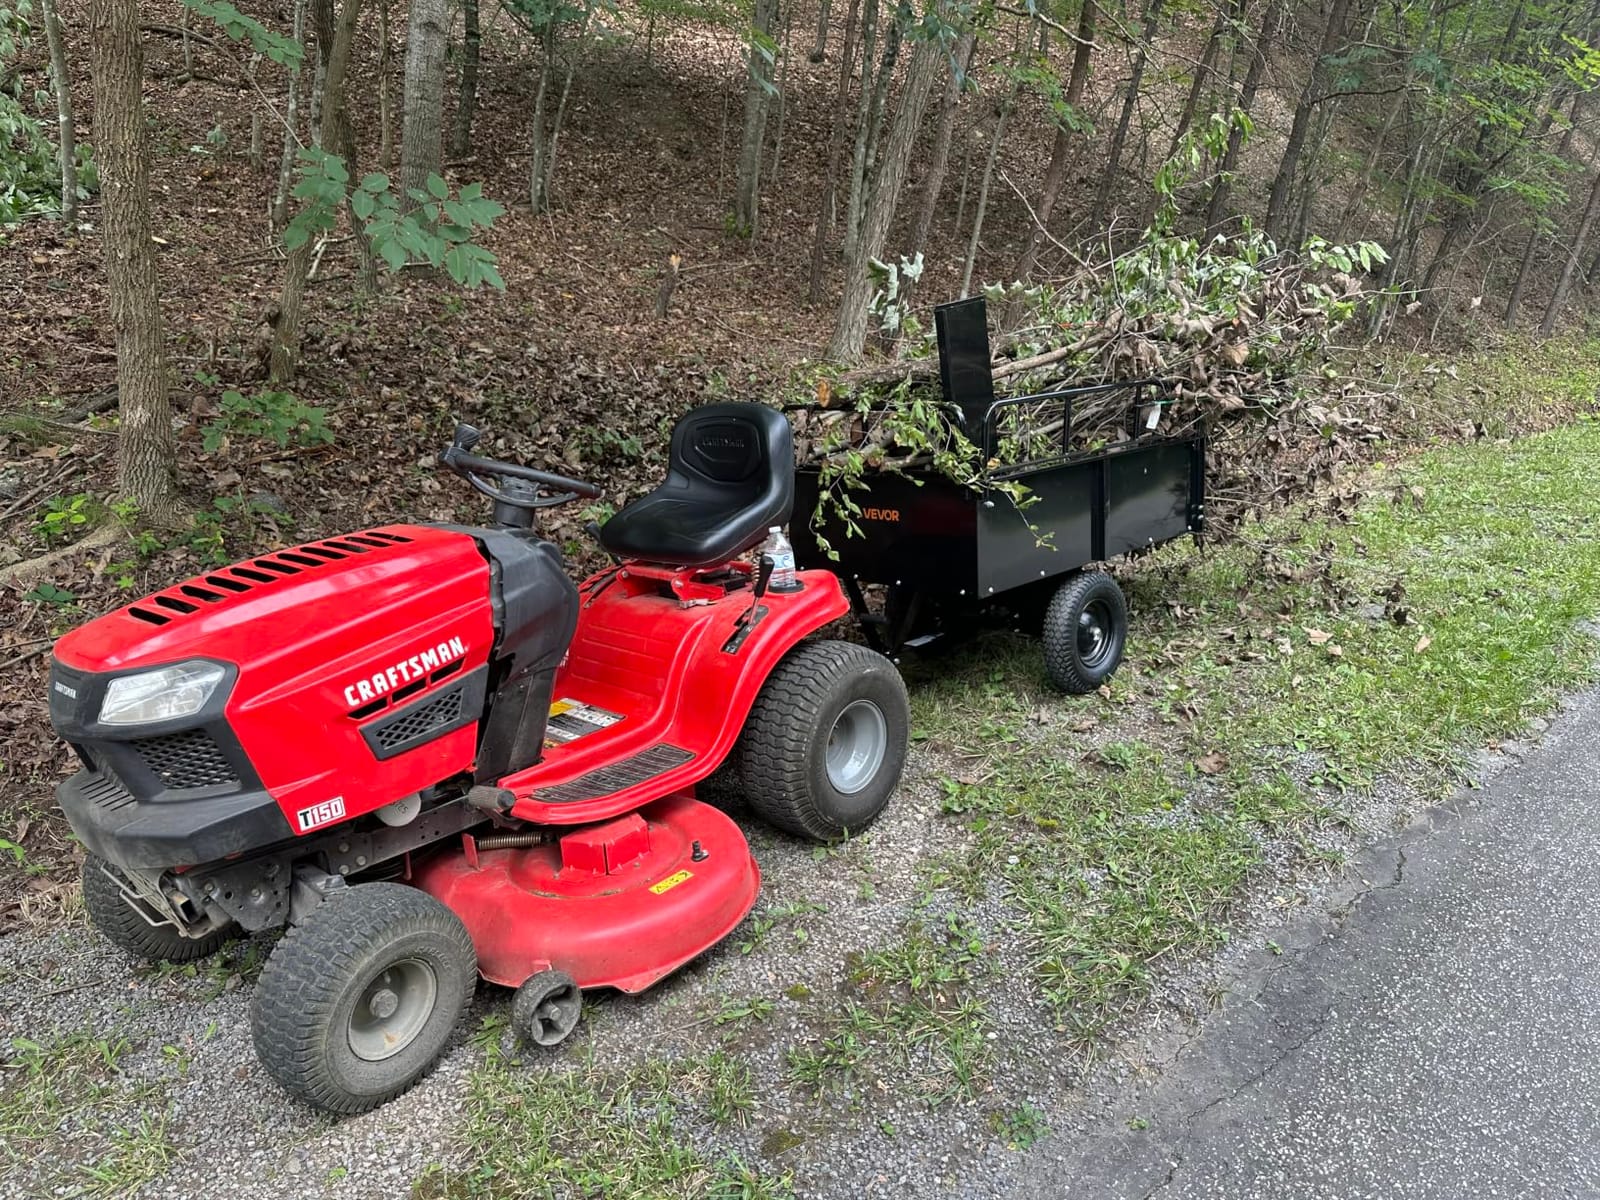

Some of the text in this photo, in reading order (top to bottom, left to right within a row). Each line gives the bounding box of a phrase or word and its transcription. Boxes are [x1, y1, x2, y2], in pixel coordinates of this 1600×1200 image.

[862, 508, 900, 521] VEVOR
[343, 636, 465, 706] CRAFTSMAN
[299, 797, 345, 828] T150
